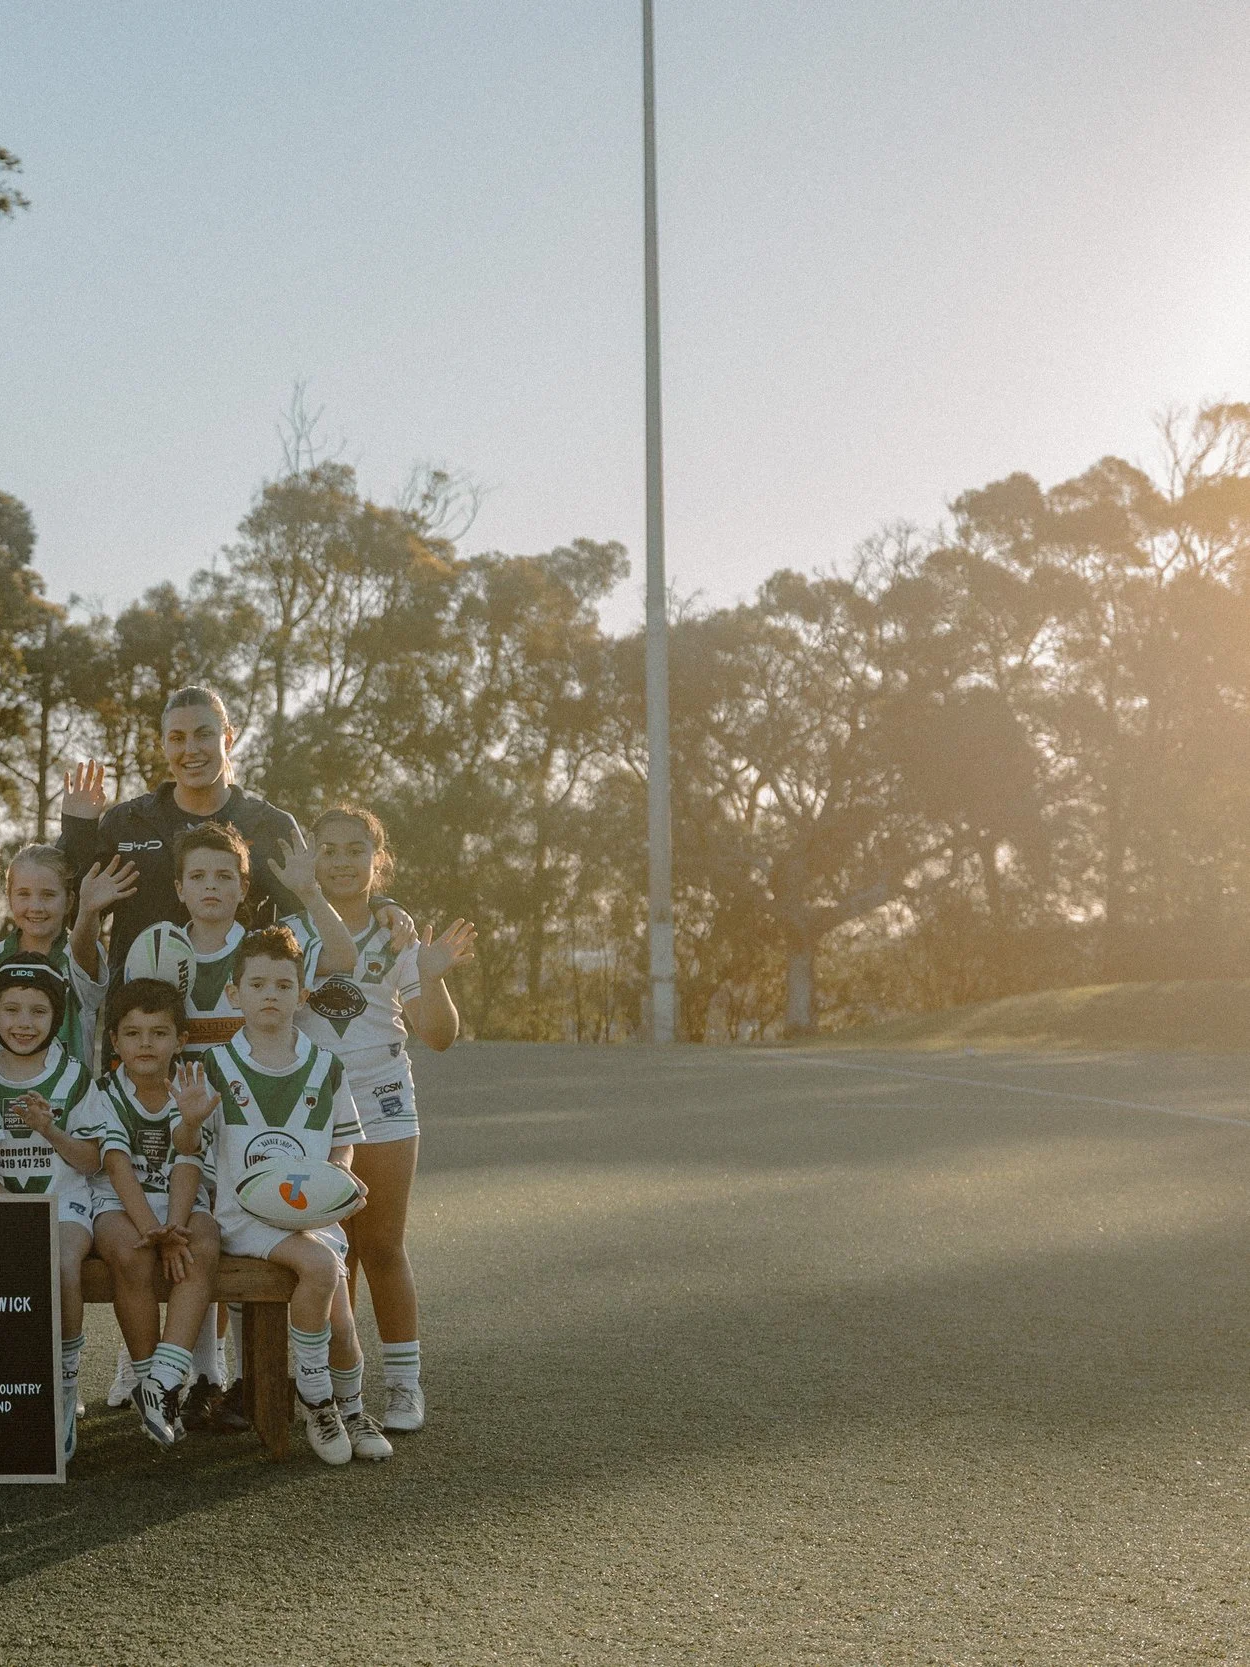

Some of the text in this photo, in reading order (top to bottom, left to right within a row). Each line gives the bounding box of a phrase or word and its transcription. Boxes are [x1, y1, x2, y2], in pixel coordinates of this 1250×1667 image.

[118, 840, 163, 852] BYD
[318, 1003, 338, 1015] THE
[383, 1081, 404, 1093] CSM
[17, 1159, 32, 1169] 147
[34, 1158, 51, 1168] 259
